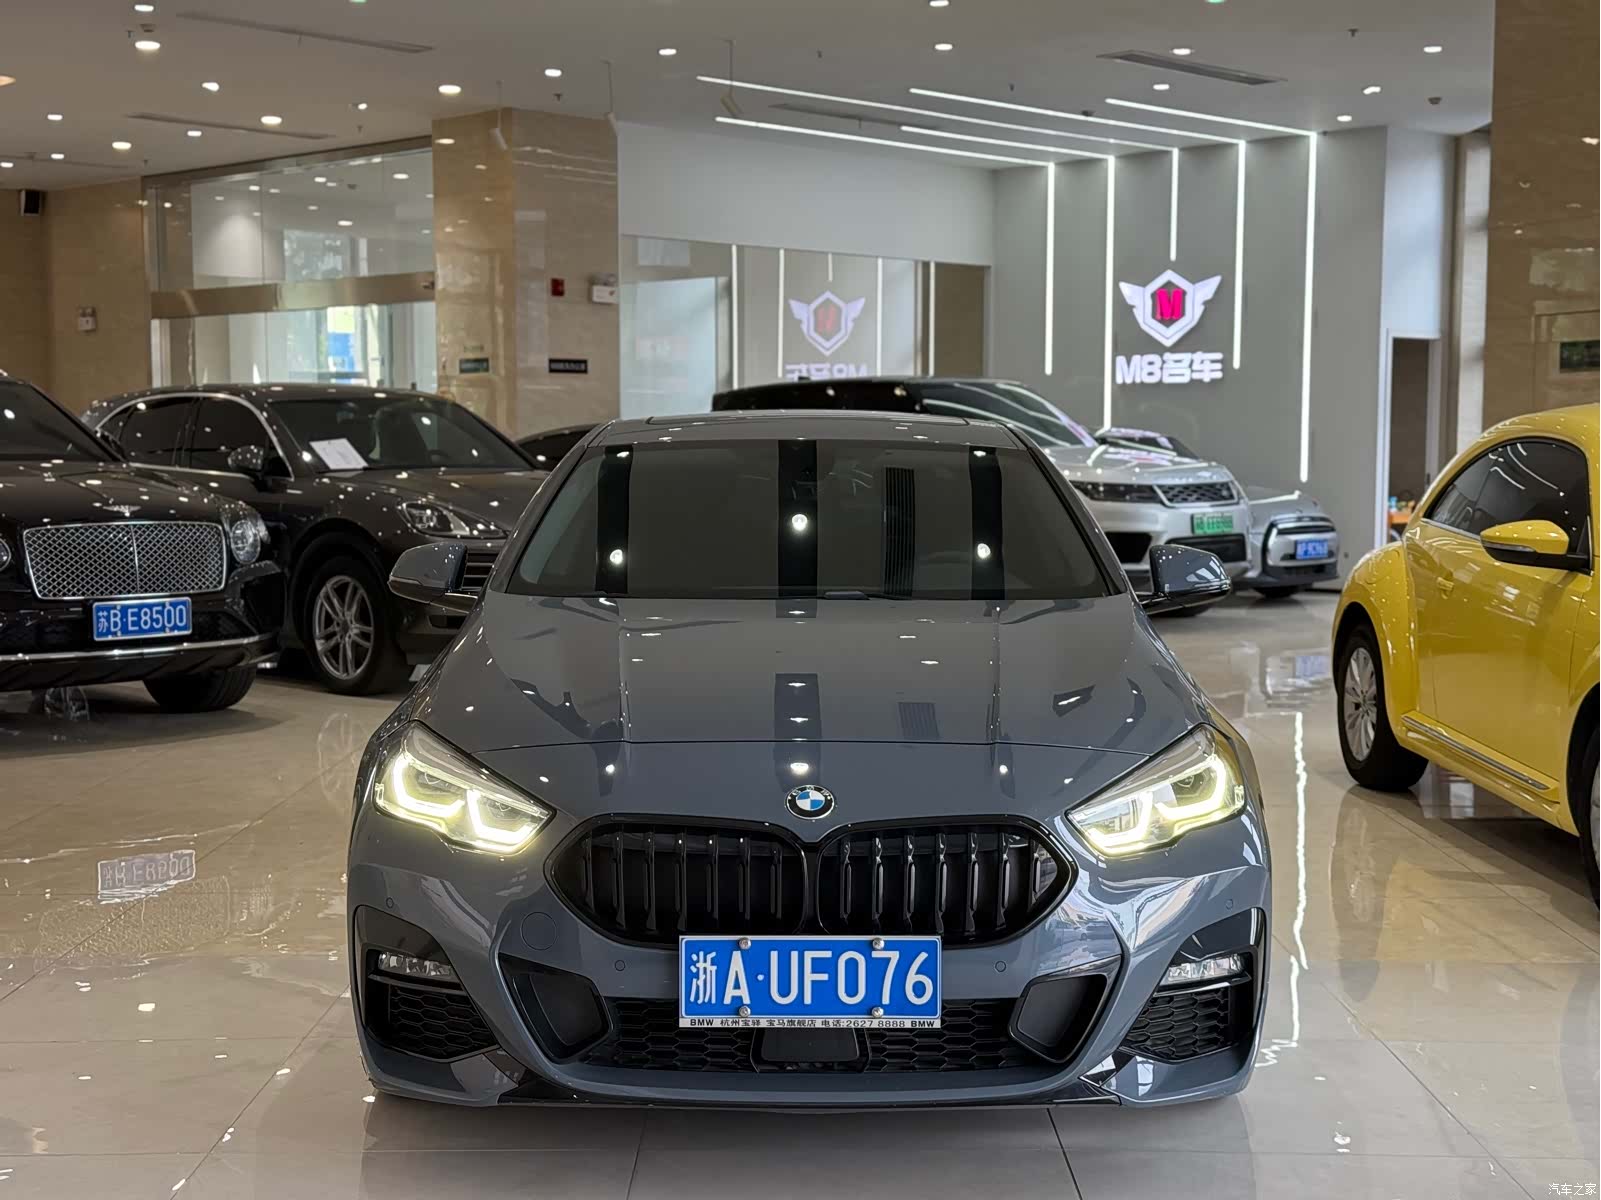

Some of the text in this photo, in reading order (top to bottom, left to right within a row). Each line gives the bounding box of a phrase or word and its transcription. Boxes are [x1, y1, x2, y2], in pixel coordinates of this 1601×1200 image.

[1115, 351, 1223, 384] M8名车
[690, 950, 934, 1005] 浙A·UF076
[690, 1018, 714, 1027] BMW
[877, 1019, 906, 1028] 8888
[910, 1019, 935, 1028] BMW
